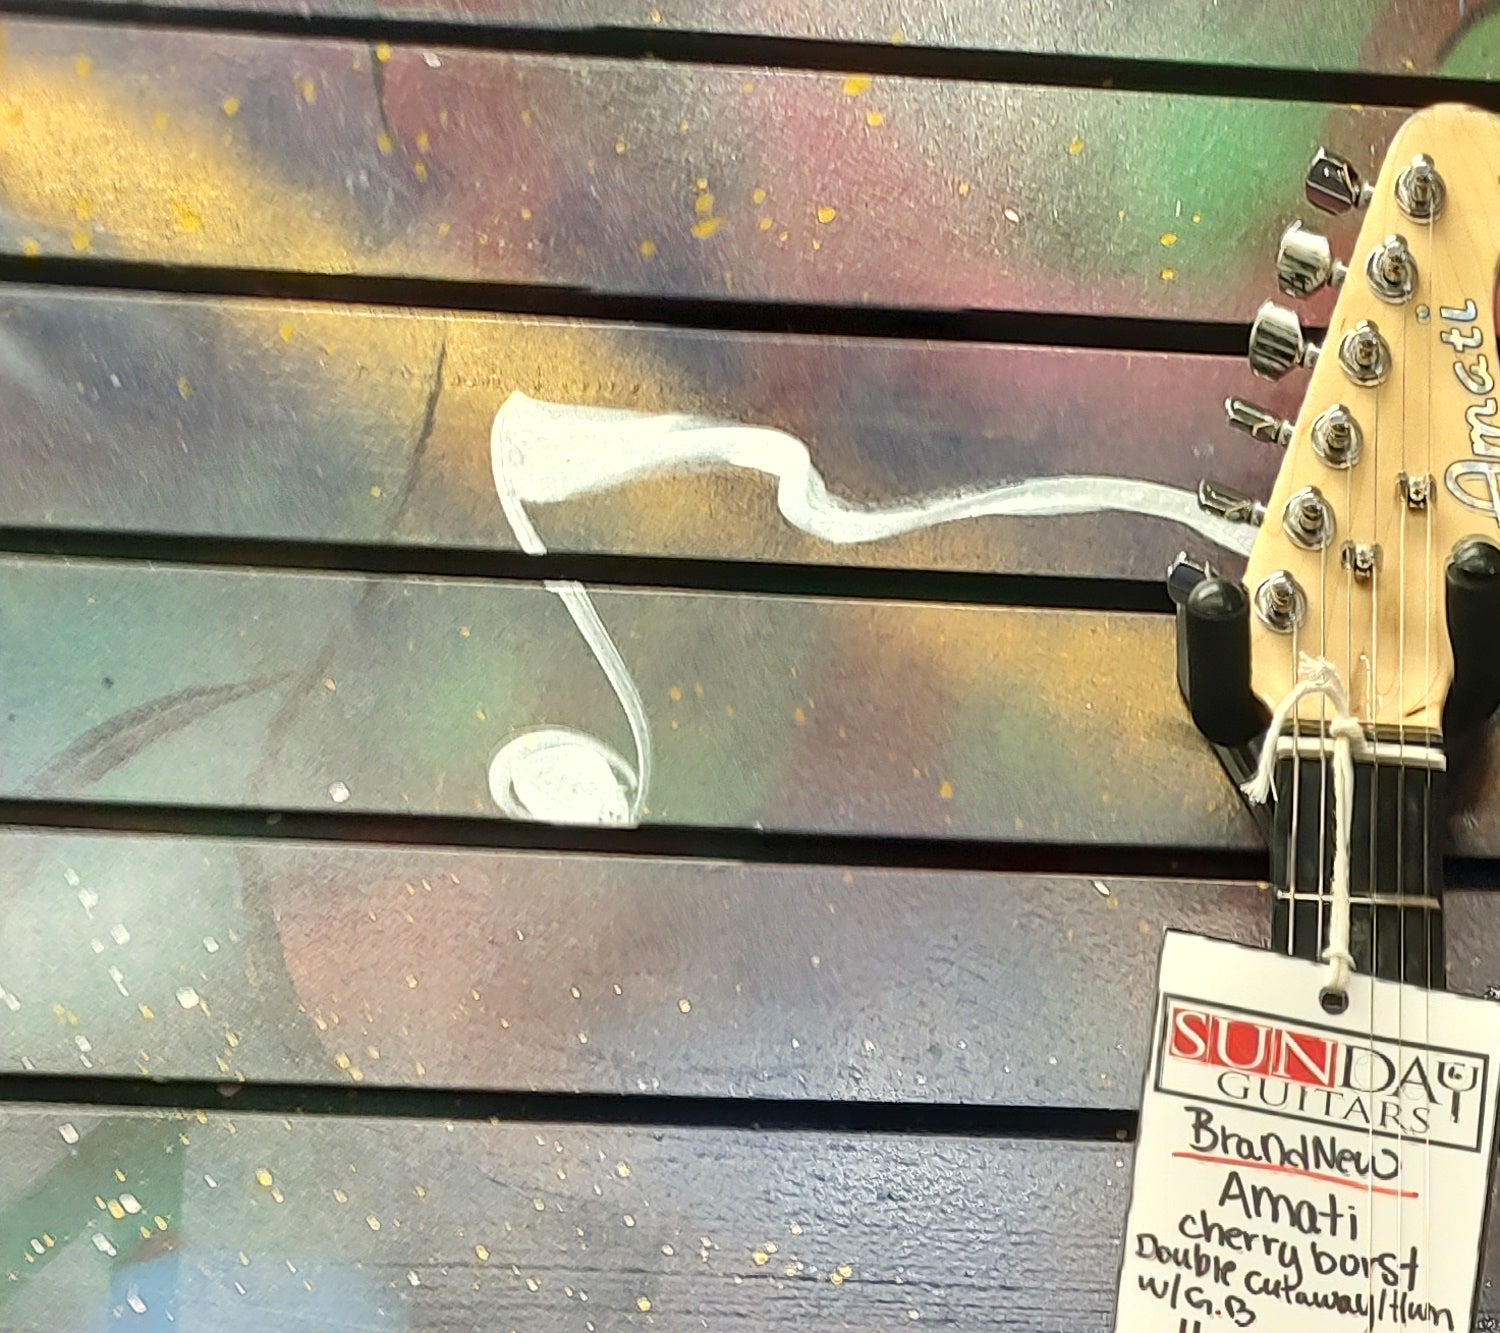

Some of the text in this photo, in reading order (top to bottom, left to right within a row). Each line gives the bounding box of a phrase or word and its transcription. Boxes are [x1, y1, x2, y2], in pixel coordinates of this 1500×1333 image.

[1170, 1008, 1479, 1124] SUNDAY
[1216, 1070, 1431, 1135] GUITARS
[1217, 1170, 1358, 1241] Amati
[1135, 1233, 1237, 1286] Double
